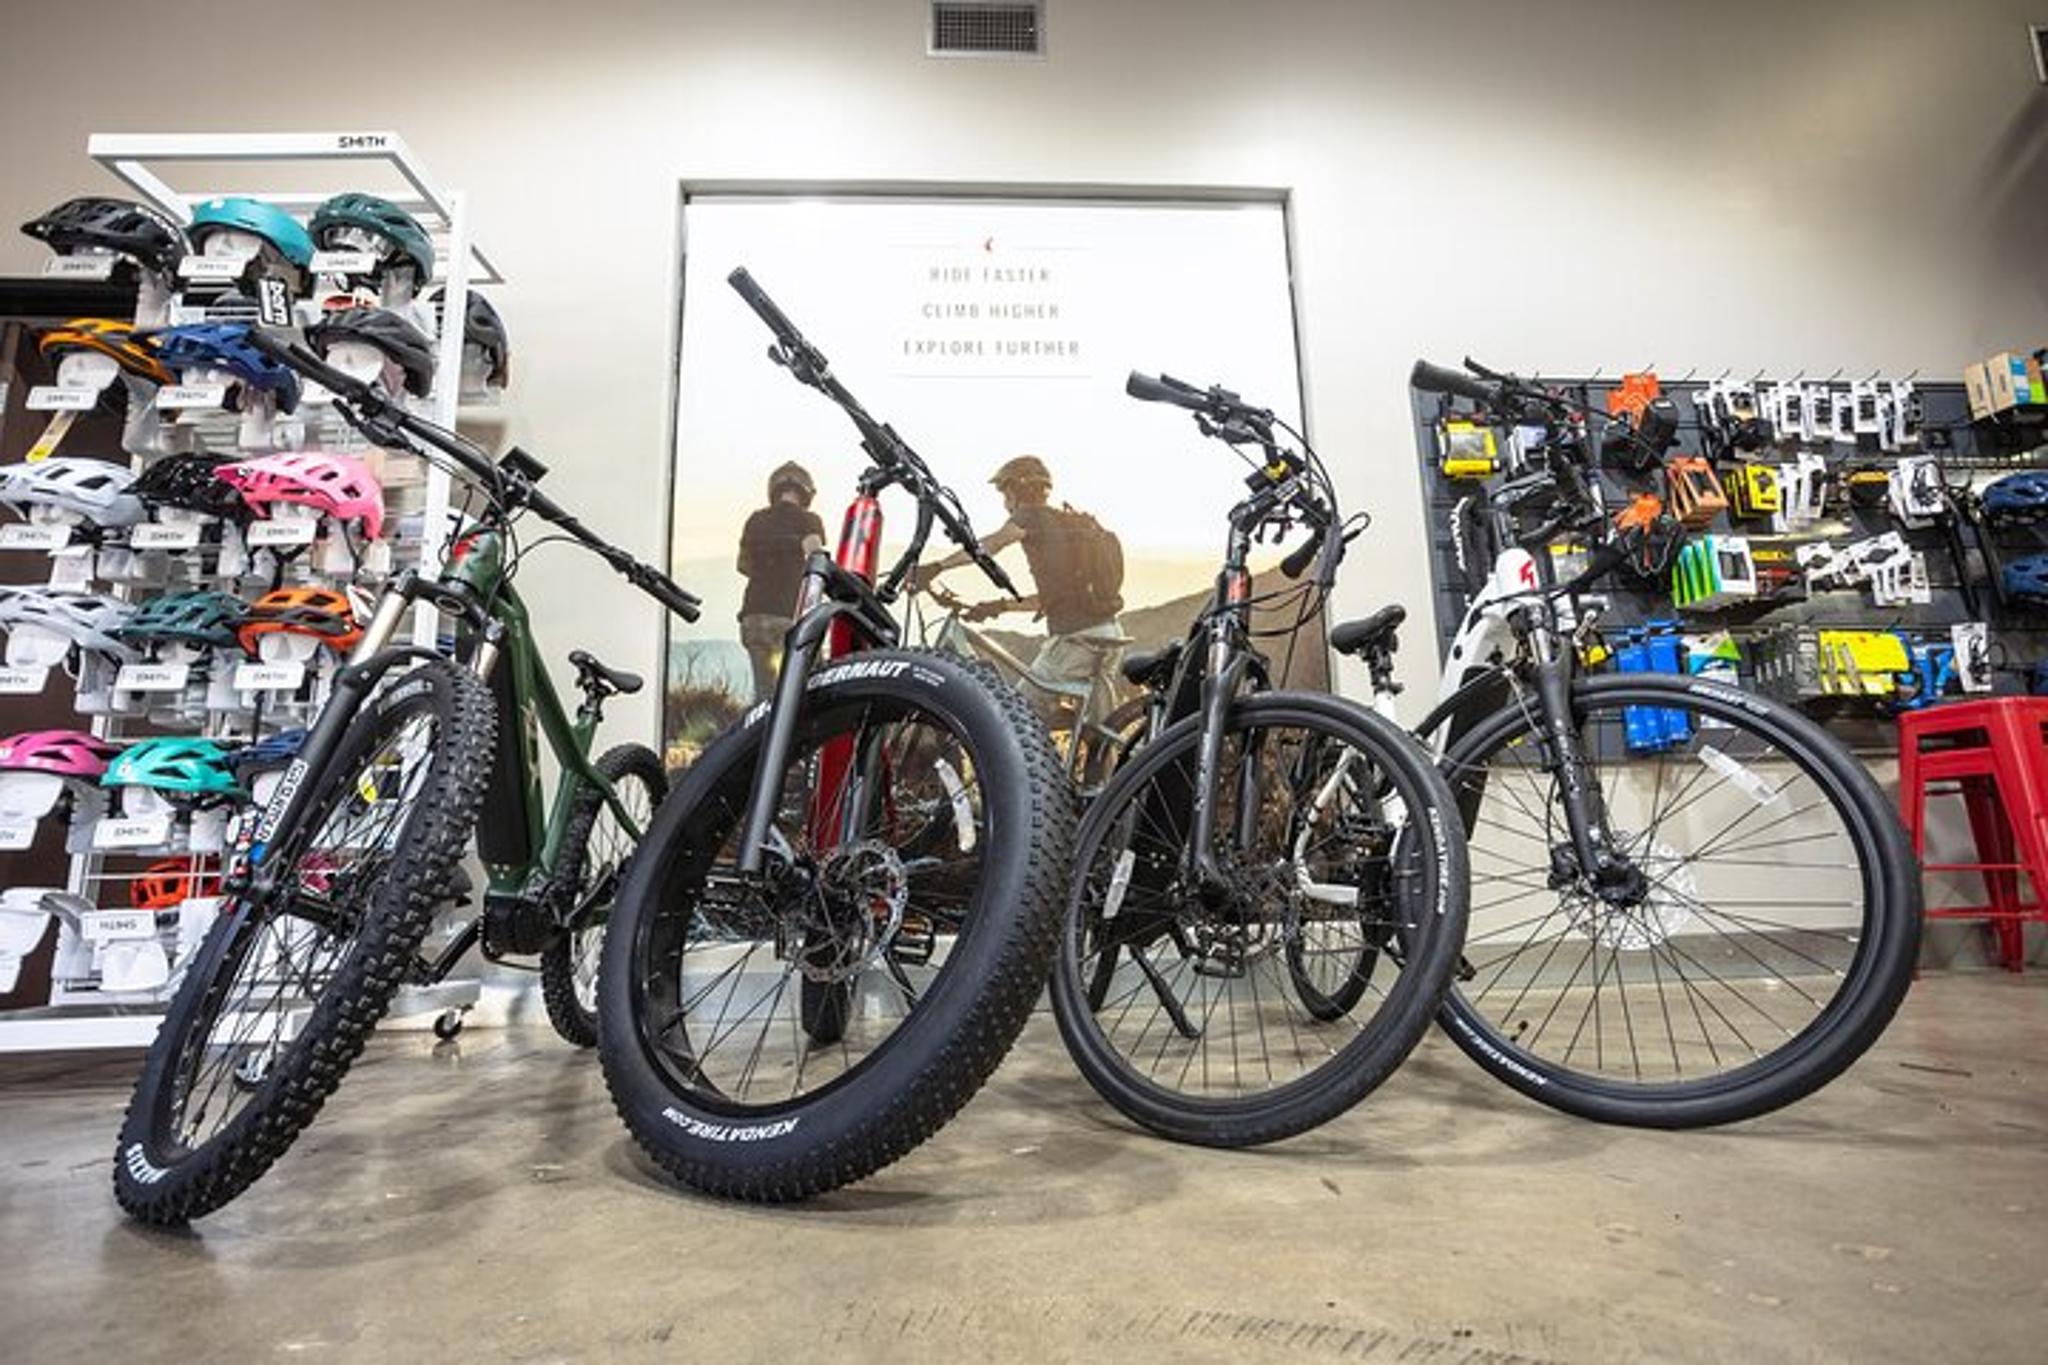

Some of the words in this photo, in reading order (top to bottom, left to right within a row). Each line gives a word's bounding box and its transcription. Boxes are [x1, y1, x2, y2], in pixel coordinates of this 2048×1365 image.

[337, 135, 386, 148] SMITH
[929, 267, 971, 282] RIDE
[983, 267, 1051, 282] FASTER
[922, 303, 979, 319] CLIMB
[989, 303, 1059, 319] HIGHER
[903, 340, 983, 356] EXPLORE
[995, 340, 1080, 356] FURTHER
